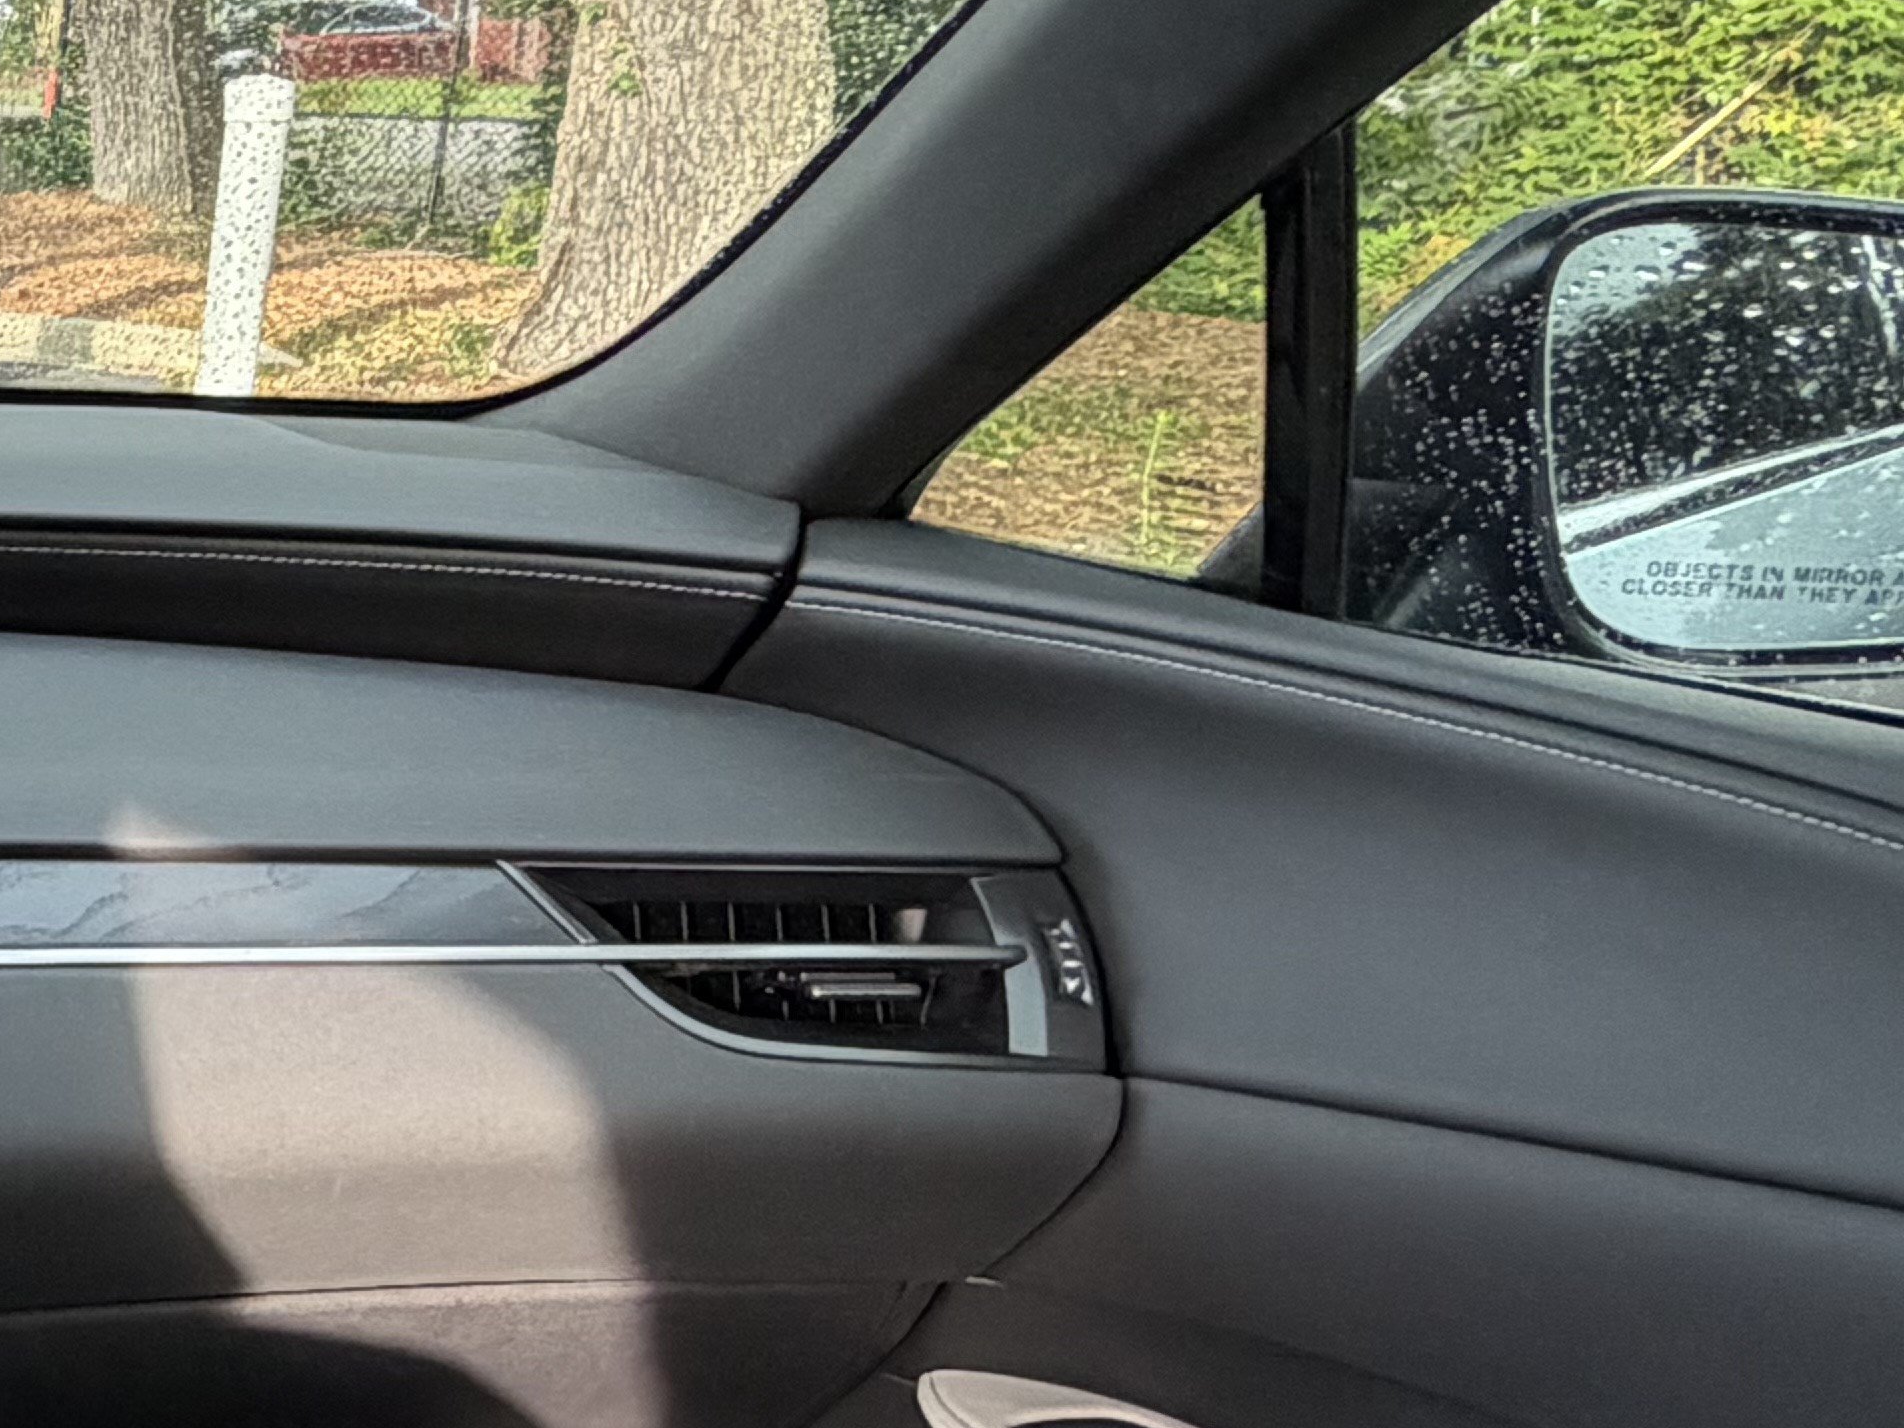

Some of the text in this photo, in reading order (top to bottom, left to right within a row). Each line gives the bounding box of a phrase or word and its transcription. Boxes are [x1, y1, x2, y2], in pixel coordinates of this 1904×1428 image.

[1646, 560, 1755, 582] OBJECTS
[1761, 565, 1785, 582] IN
[1793, 566, 1885, 586] MIRROR
[1620, 578, 1713, 598] CLOSER
[1725, 582, 1786, 601] THAN
[1797, 586, 1858, 604] THEY
